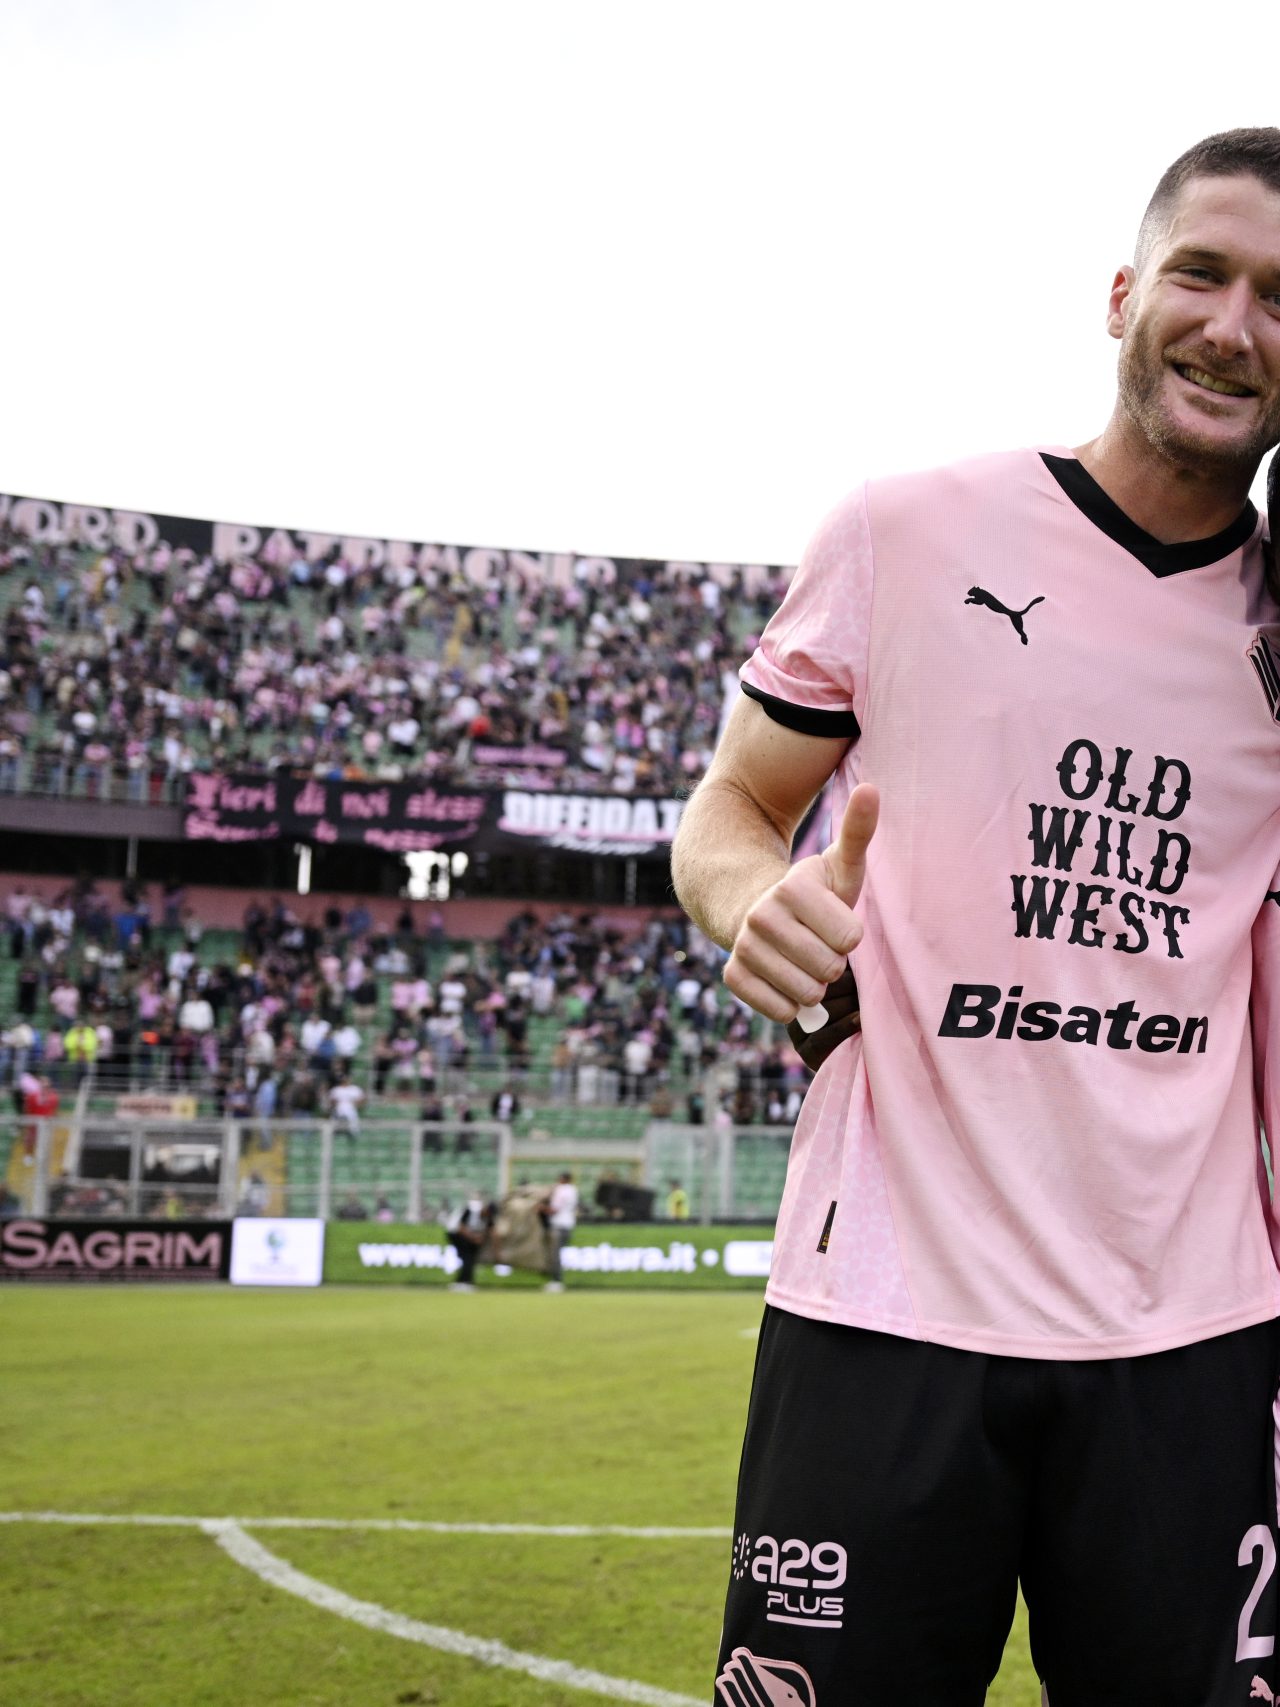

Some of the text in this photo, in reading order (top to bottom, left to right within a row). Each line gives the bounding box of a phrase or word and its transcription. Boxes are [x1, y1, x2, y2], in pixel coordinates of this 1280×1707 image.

[0, 496, 160, 556] ORD
[1056, 739, 1192, 822] OLD
[503, 792, 686, 838] DIFFIDAT
[1028, 803, 1192, 895] WILD
[1011, 875, 1190, 958] WEST
[938, 984, 1208, 1054] Bisaten
[2, 1220, 222, 1270] SAGRIM
[766, 1590, 844, 1616] PLUS
